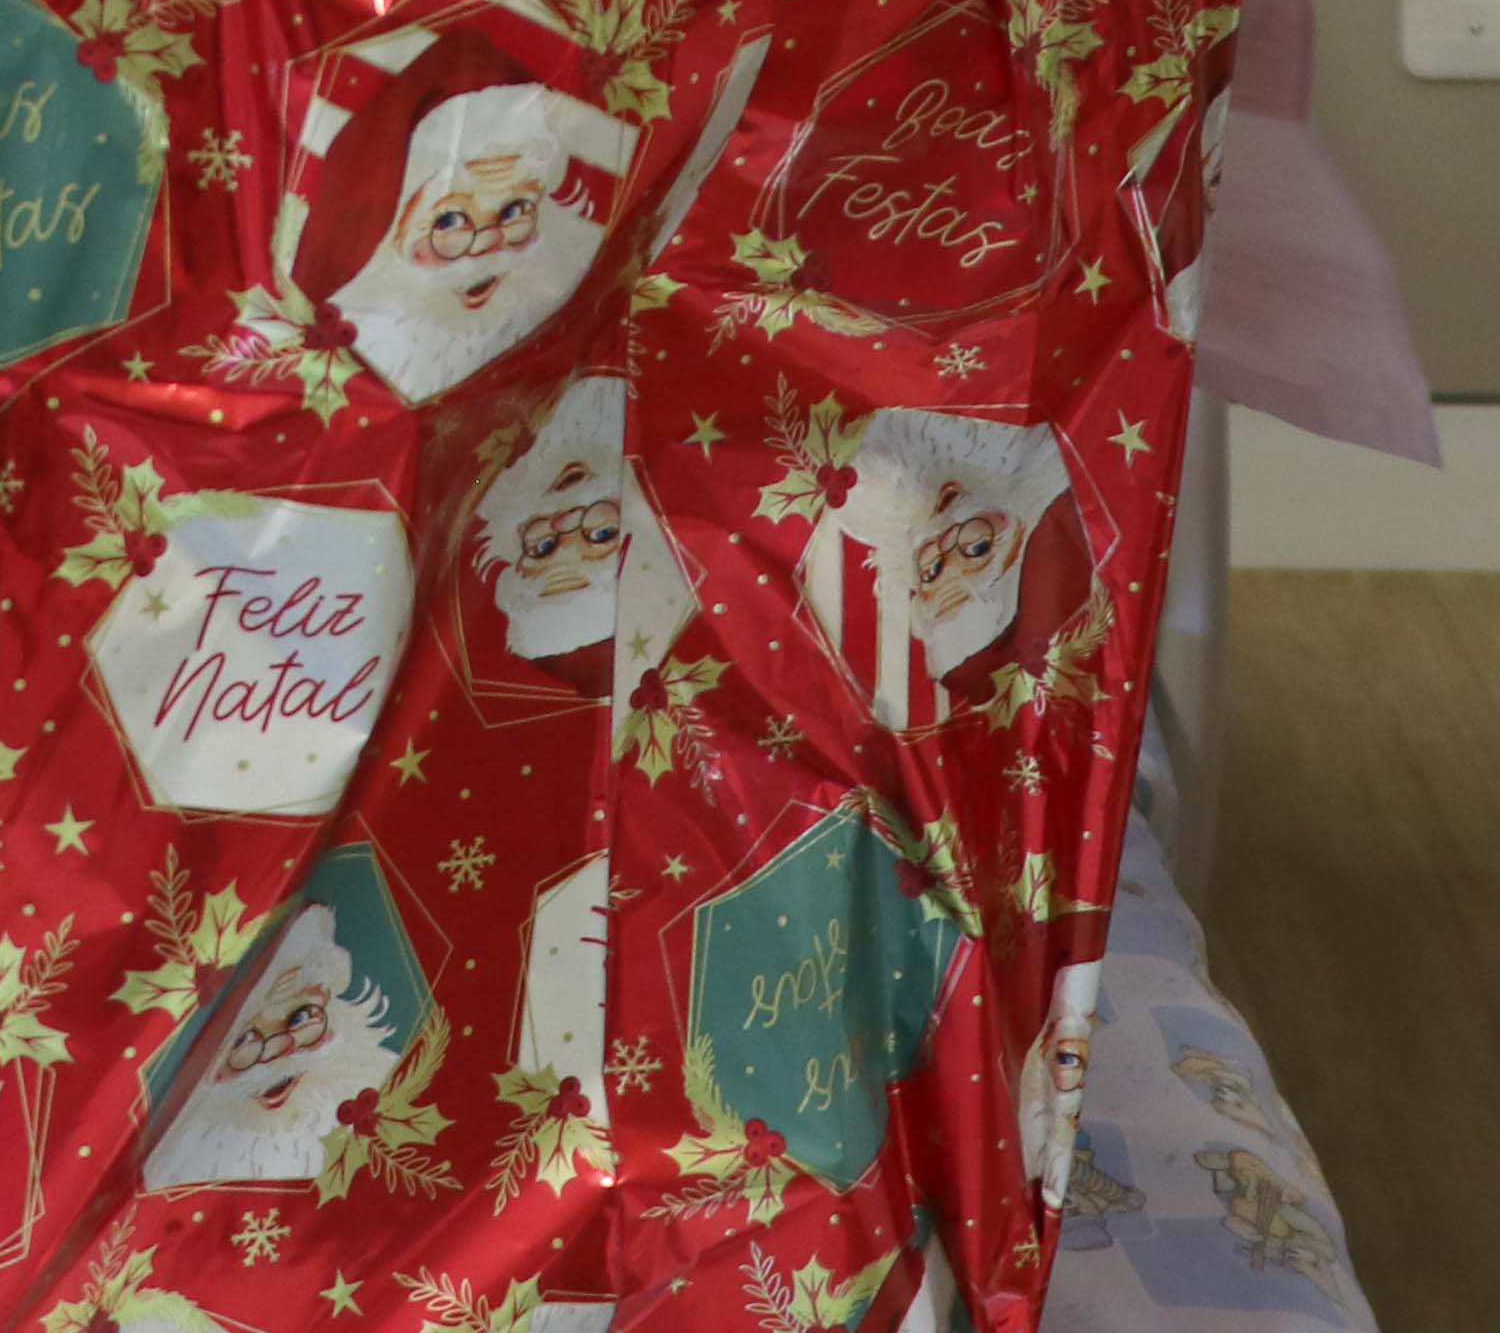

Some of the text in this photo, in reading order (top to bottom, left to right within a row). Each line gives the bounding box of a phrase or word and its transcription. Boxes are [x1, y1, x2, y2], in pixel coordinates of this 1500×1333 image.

[883, 77, 1037, 171] Boas
[796, 151, 1018, 270] Festas
[194, 565, 366, 652] Feliz
[153, 648, 382, 743] Natal
